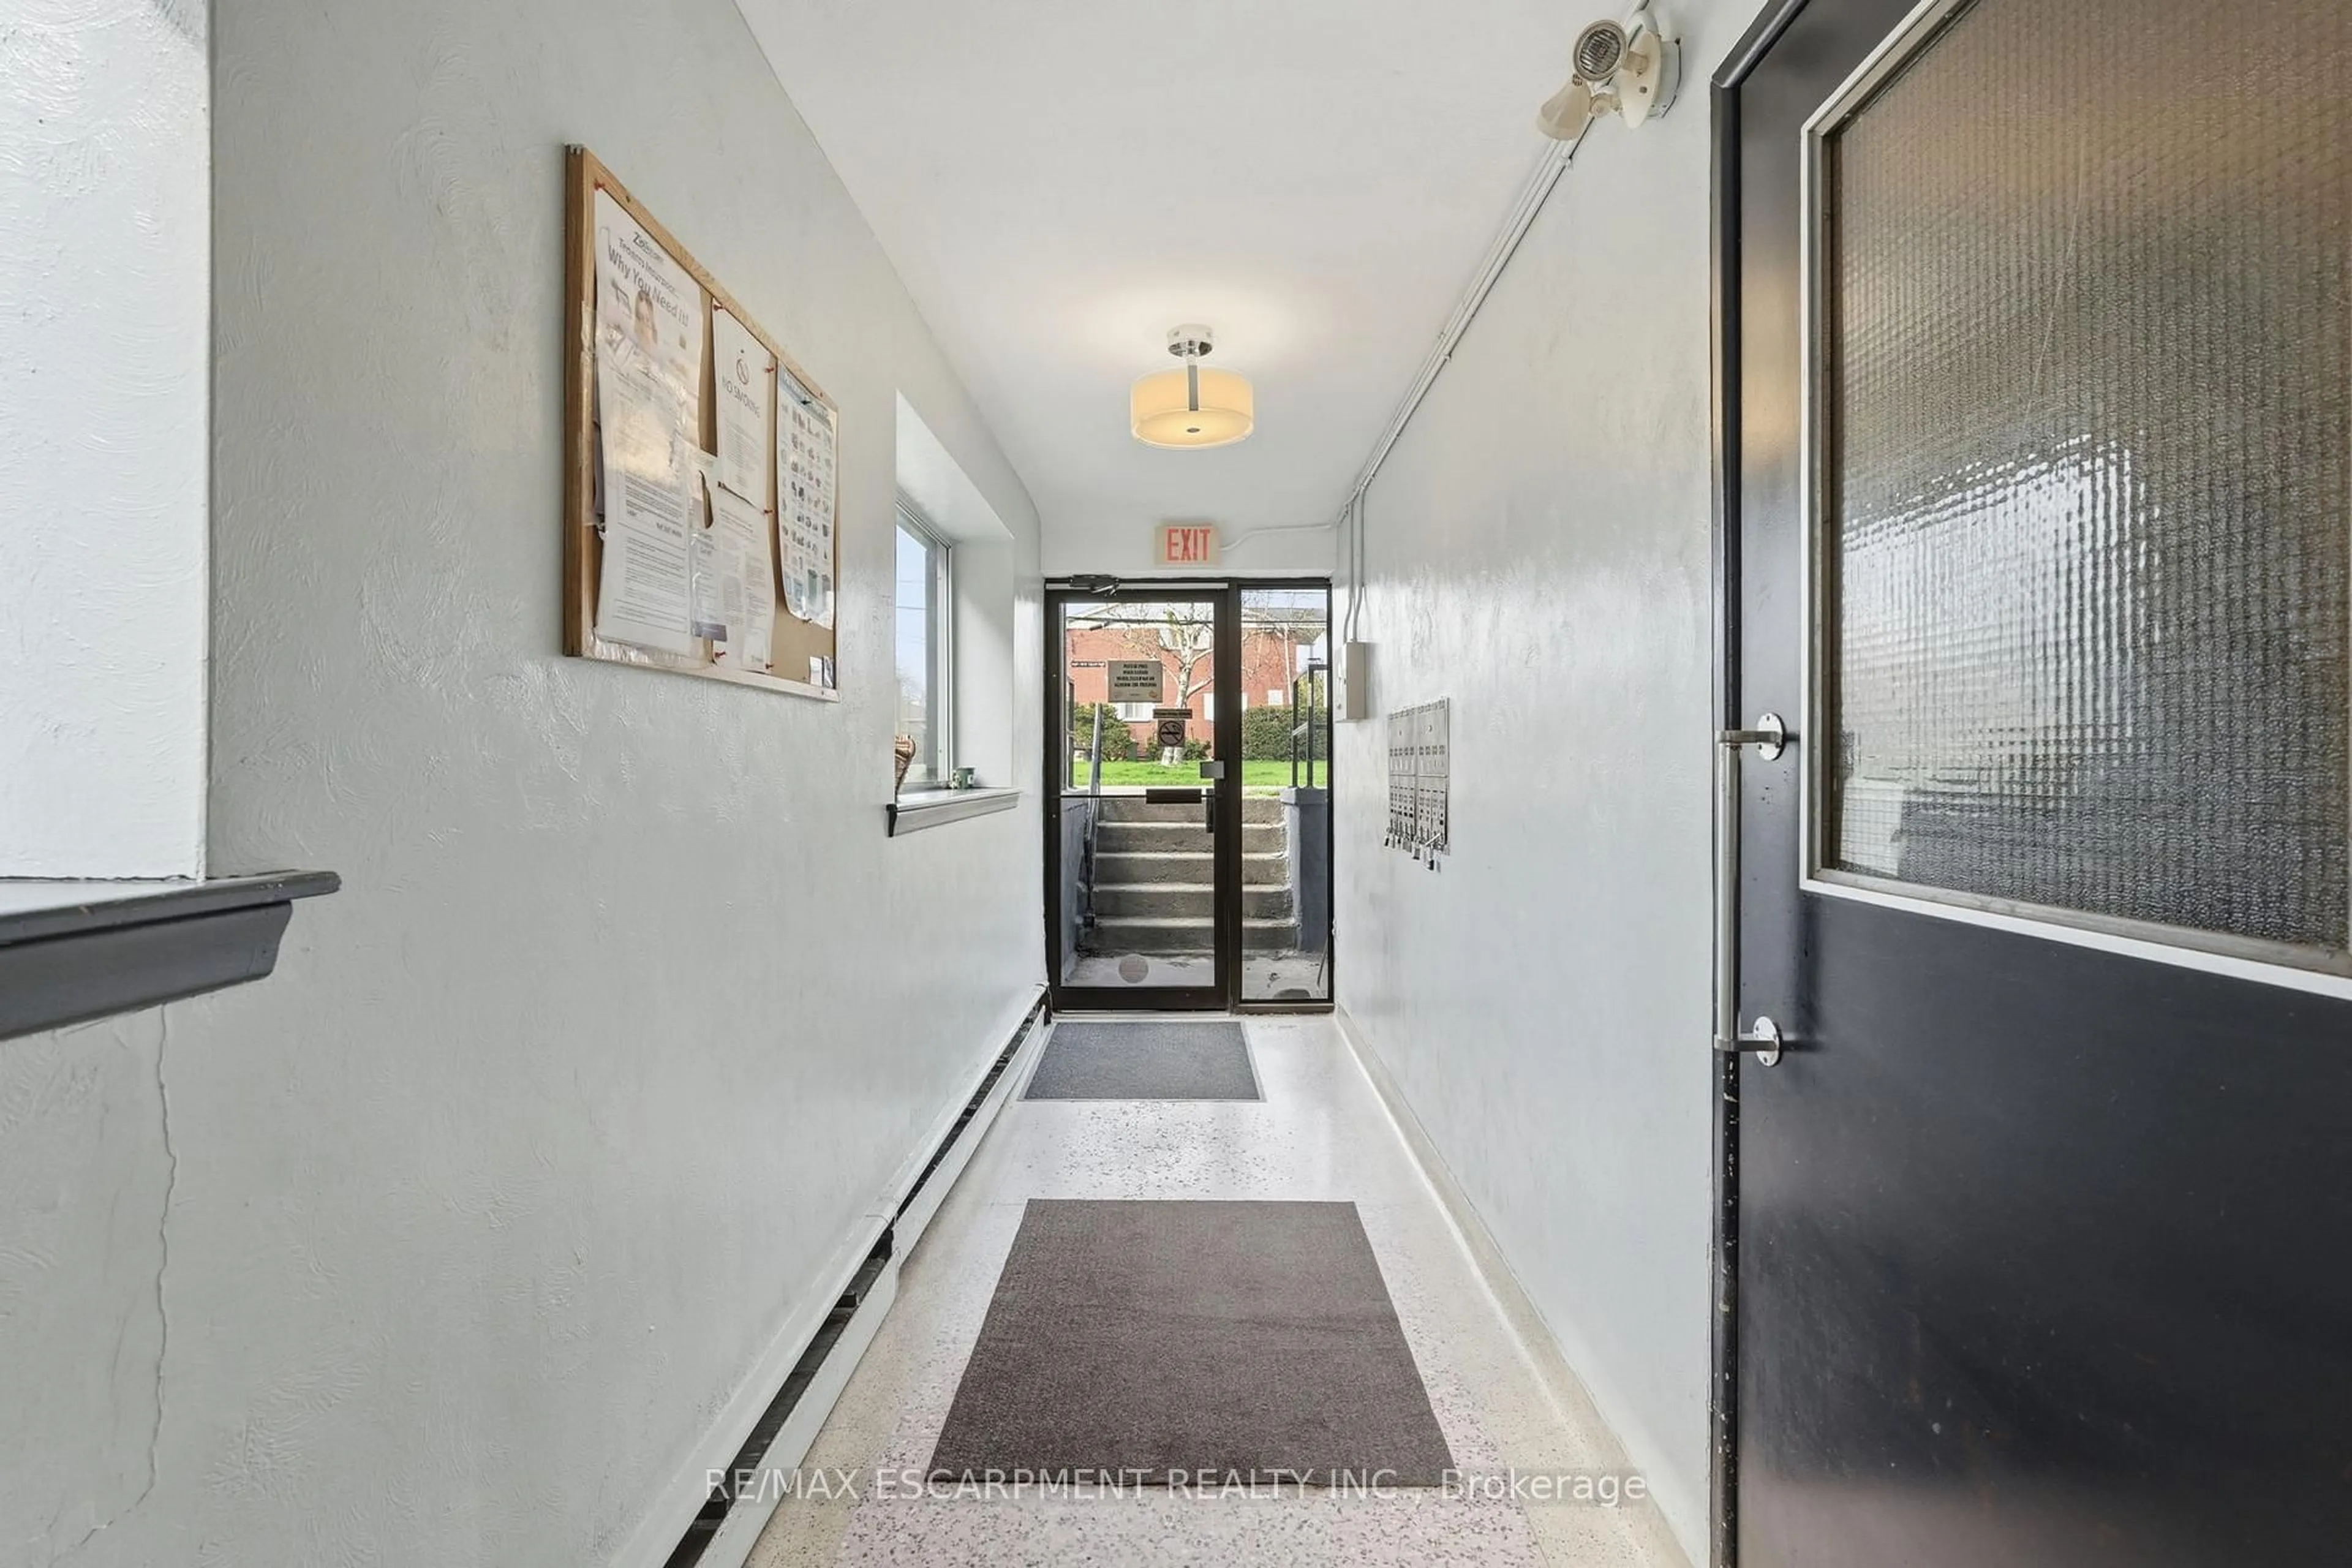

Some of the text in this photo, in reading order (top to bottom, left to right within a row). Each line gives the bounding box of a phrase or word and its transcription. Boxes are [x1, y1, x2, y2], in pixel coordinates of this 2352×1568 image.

[609, 245, 630, 279] Why
[633, 268, 650, 295] You
[652, 286, 678, 318] Need
[1166, 528, 1211, 562] EXIT
